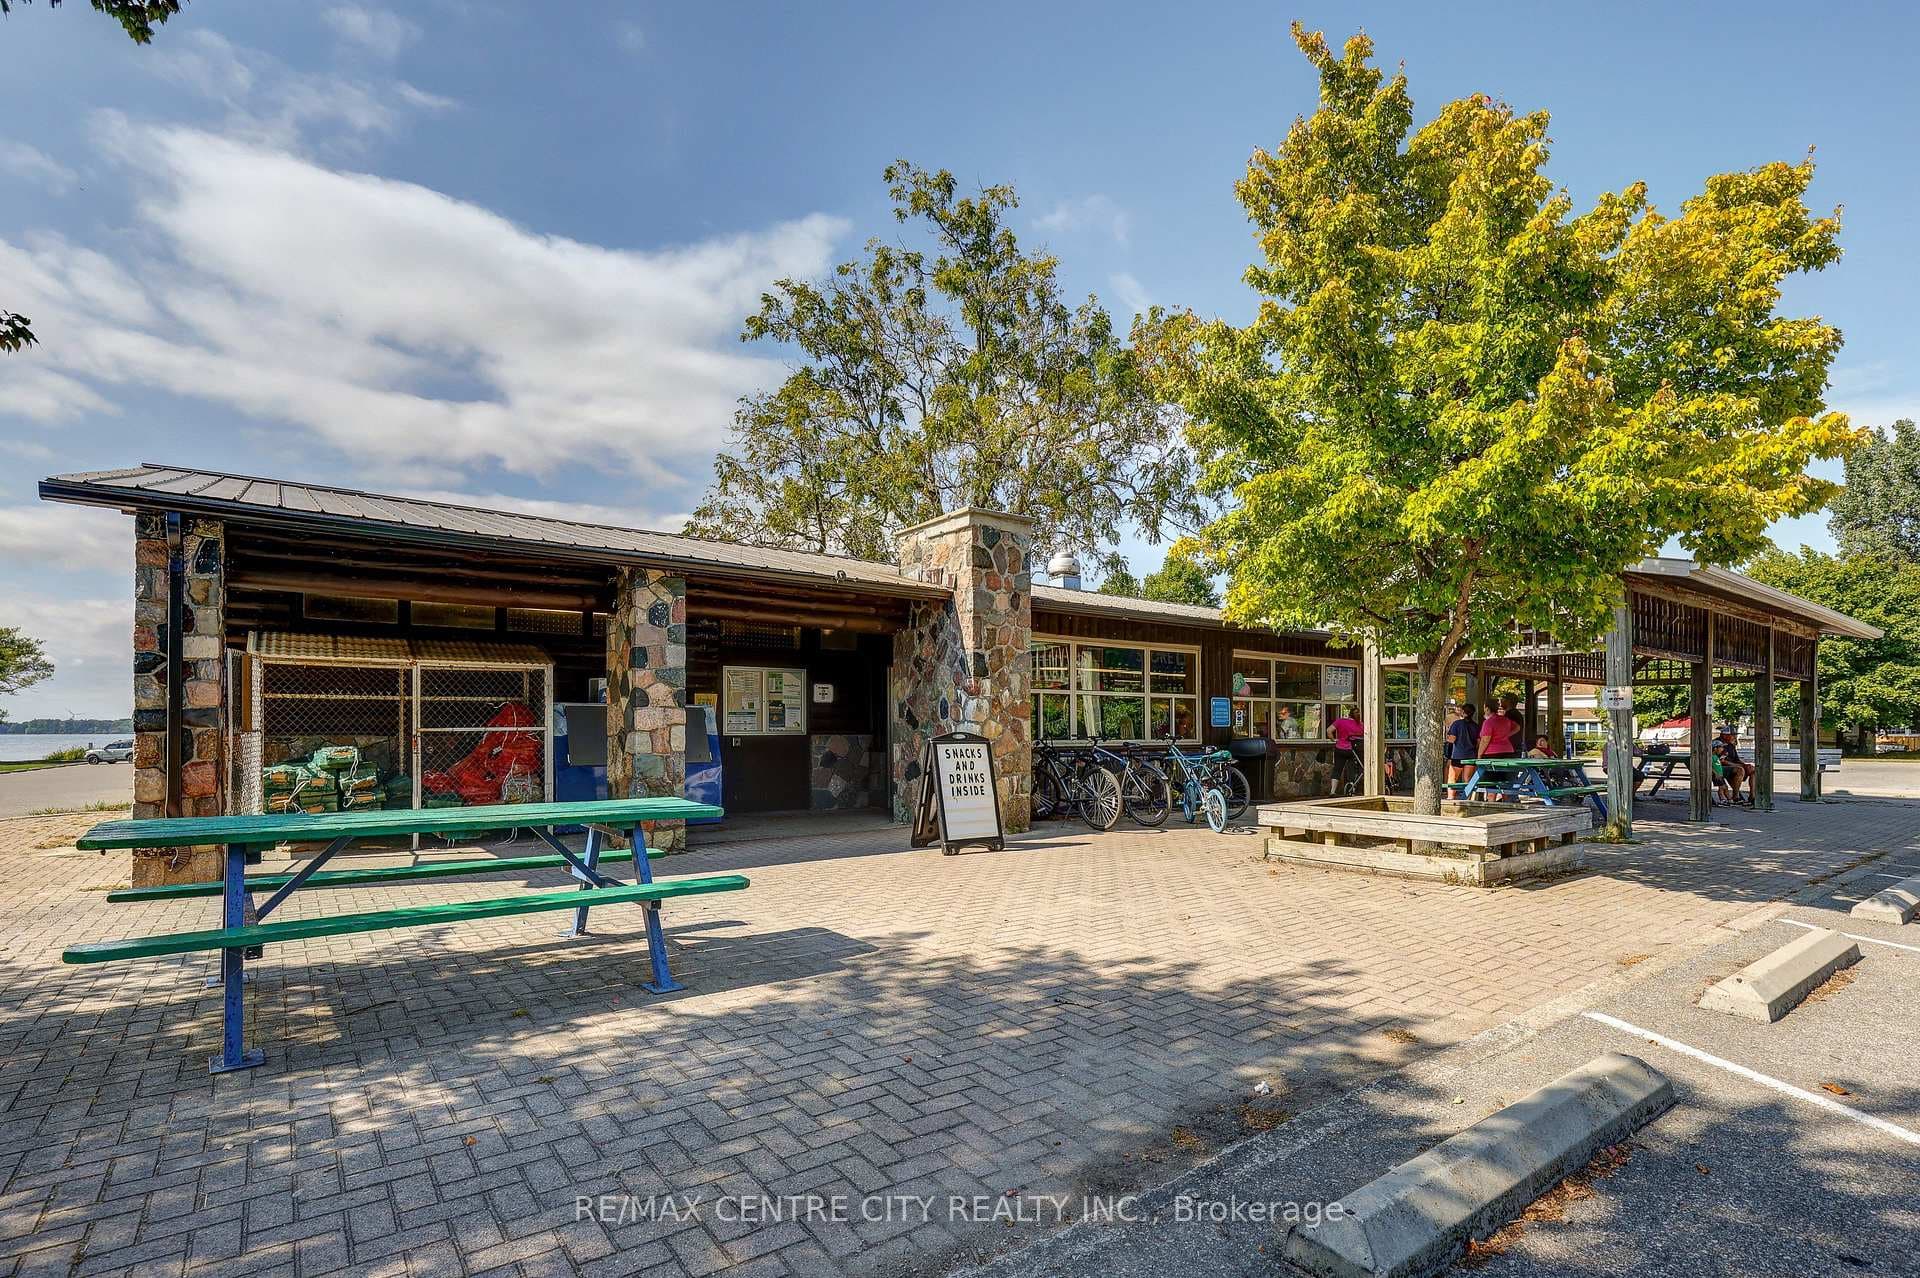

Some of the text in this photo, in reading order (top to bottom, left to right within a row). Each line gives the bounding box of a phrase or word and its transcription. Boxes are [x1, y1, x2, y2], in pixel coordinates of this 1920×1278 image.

[945, 748, 982, 759] SNACKS
[955, 761, 975, 771] AND
[949, 773, 985, 784] DRINKS
[951, 786, 985, 797] INSIDE
